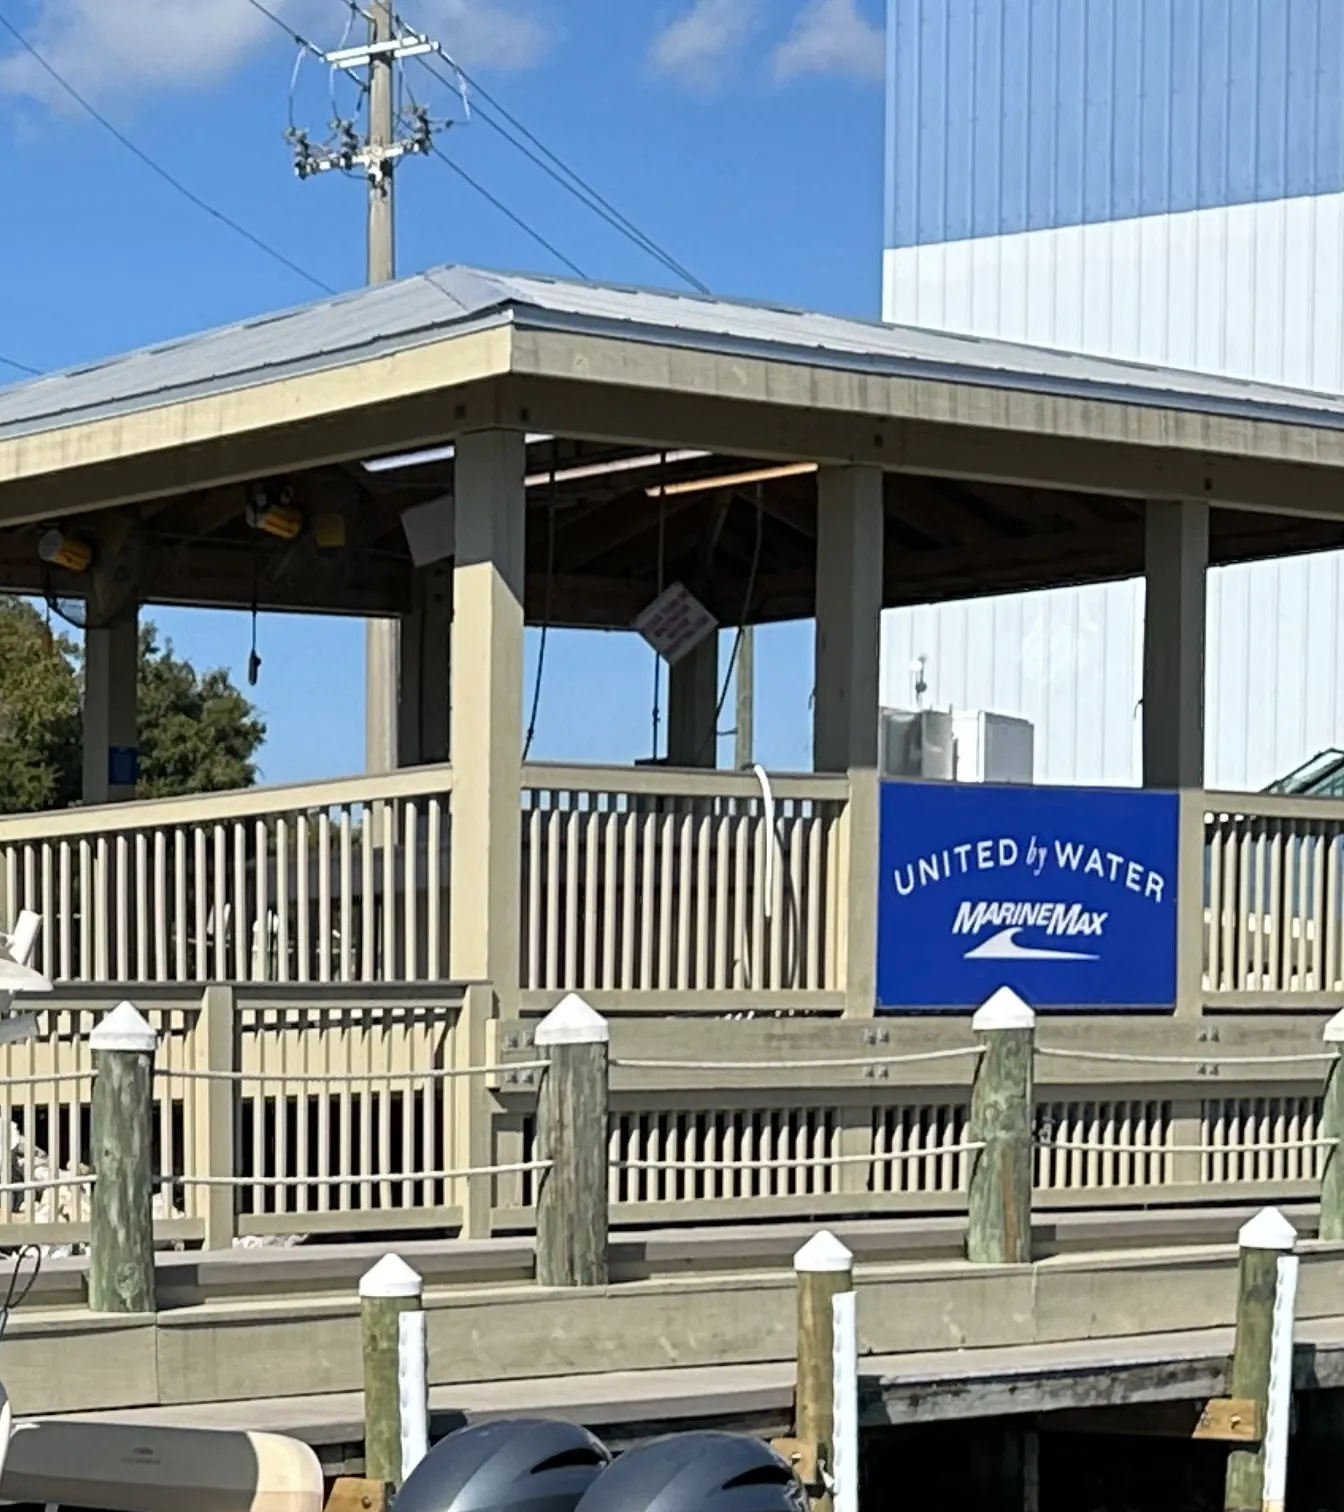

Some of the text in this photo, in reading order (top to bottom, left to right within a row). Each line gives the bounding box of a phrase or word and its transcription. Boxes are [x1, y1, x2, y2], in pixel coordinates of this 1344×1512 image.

[894, 835, 1165, 903] UNITED by WATER
